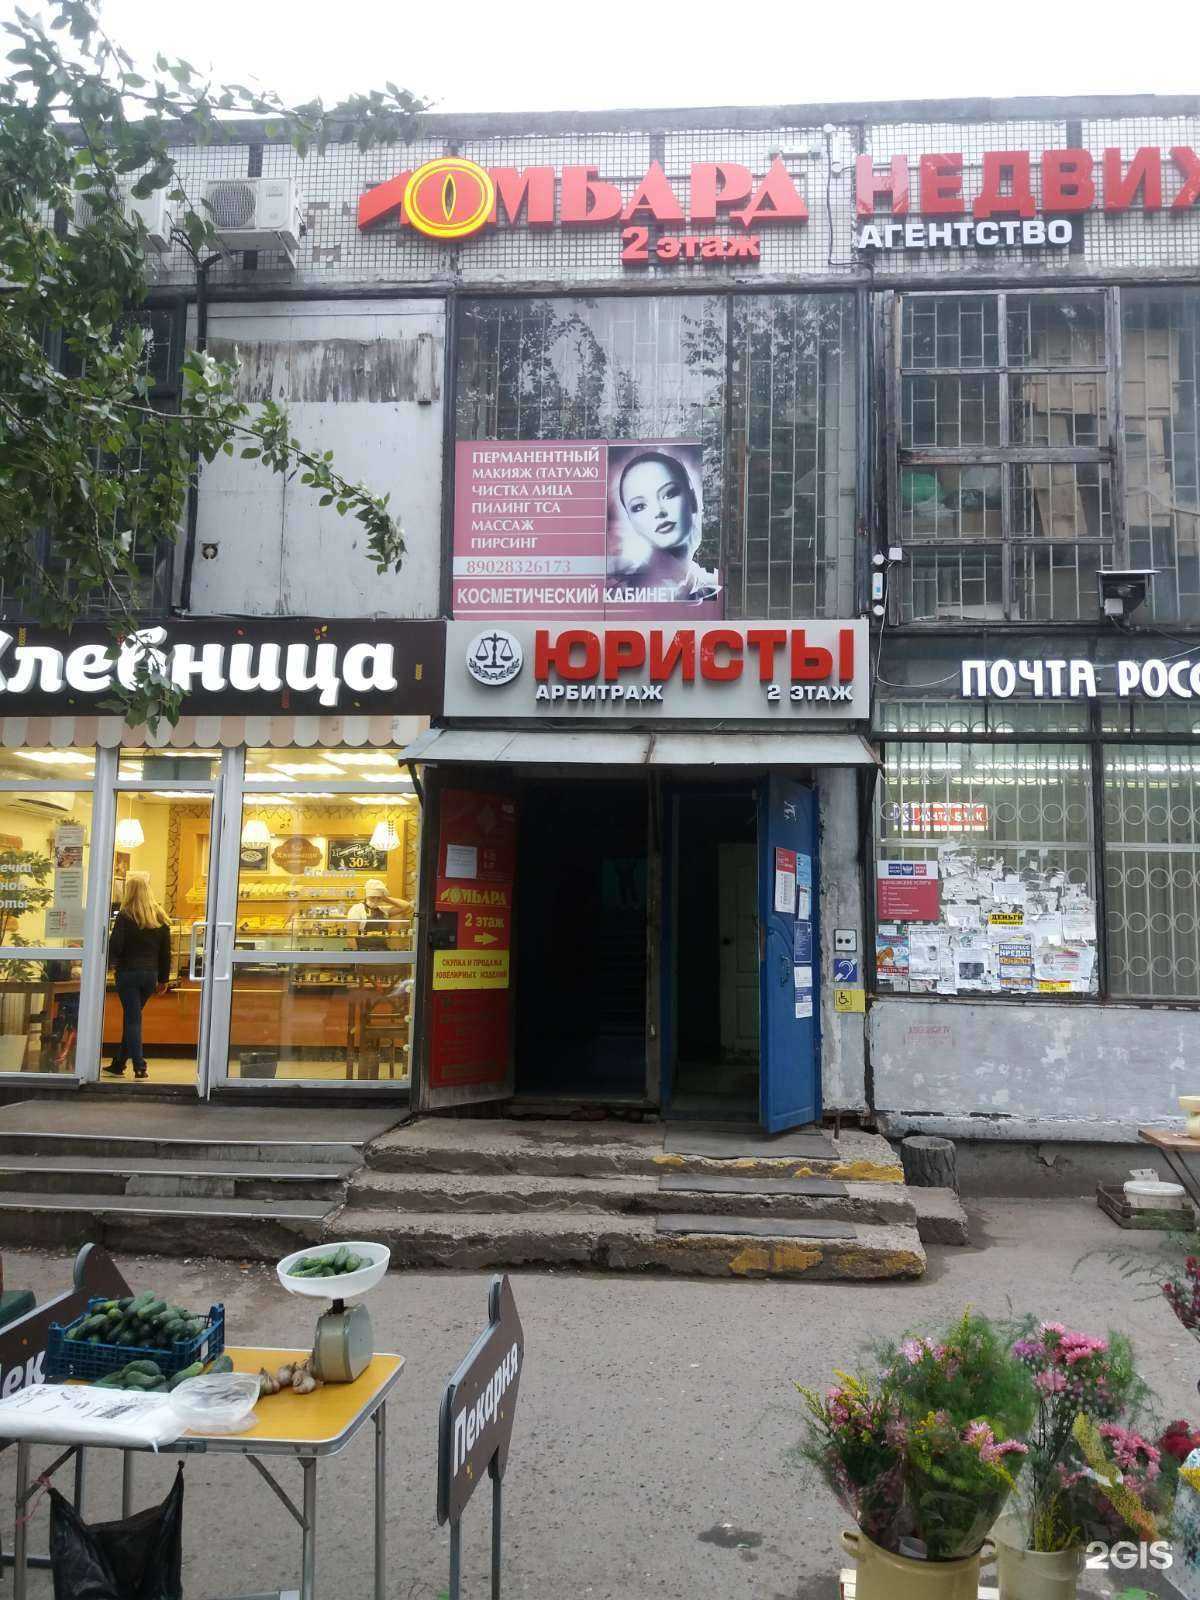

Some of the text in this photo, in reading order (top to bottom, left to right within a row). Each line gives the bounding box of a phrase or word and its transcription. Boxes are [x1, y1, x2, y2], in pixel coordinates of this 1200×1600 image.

[858, 219, 1073, 249] АГЕНТСТВО
[621, 226, 760, 264] 2 этаж
[472, 447, 600, 463] ПЕРМАНЕНТНЫЙ
[472, 467, 599, 479] МАКИЯЖ (ТАТУАЖ)
[472, 484, 573, 496] ЧИСТКА ЛИЦА
[471, 501, 561, 513] ПИЛИНГ ТСА
[471, 519, 534, 531] МАССАЖ
[471, 537, 538, 549] ПИРСИНГ
[466, 560, 571, 574] 89028326173
[457, 584, 677, 604] КОСМЕТИЧЕСКИЙ КАБИНЕТ
[534, 629, 854, 682] ЮРИСТЫ
[961, 659, 1097, 698] ПОЧТА
[535, 684, 854, 701] АРБИТРАЖ 2 ЭТАЖ
[464, 912, 505, 928] 2 этаж
[0, 1351, 46, 1400] ек
[454, 1342, 518, 1478] Пекарня
